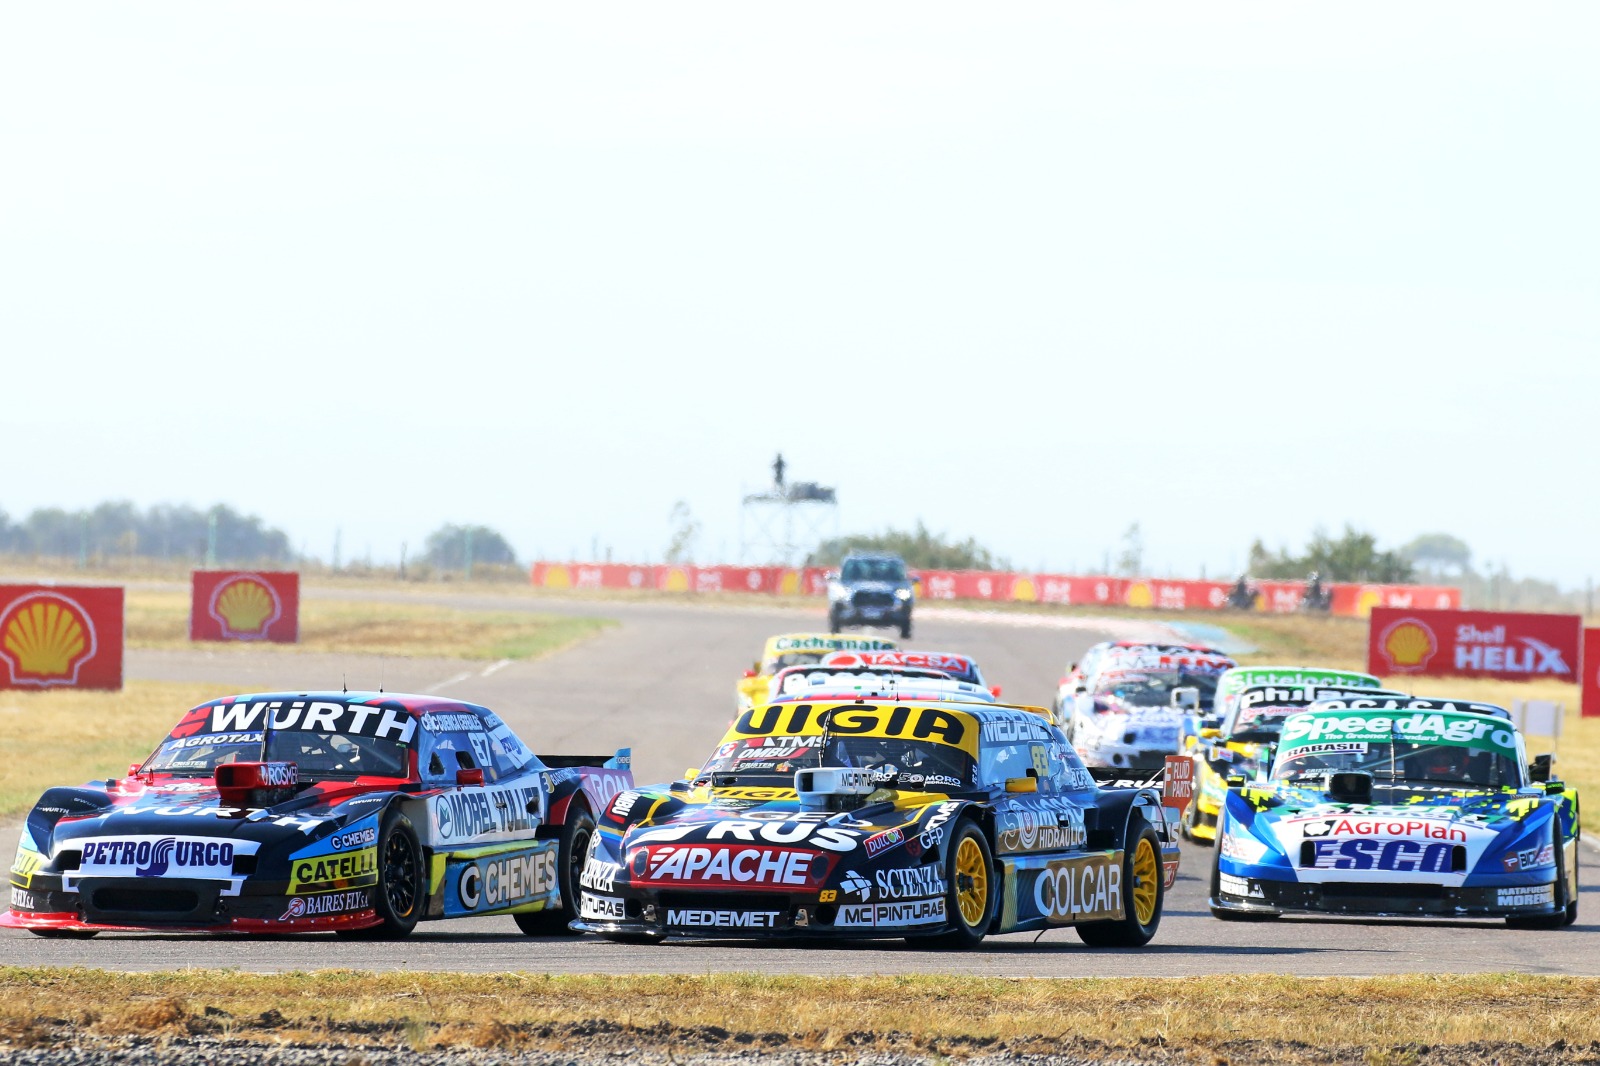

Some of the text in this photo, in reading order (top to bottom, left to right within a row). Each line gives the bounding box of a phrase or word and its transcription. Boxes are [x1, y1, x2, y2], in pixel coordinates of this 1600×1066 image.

[1457, 625, 1506, 643] Shell
[1455, 636, 1571, 674] HELIX
[211, 701, 417, 743] WÜRTH
[1282, 713, 1518, 749] SpeedAgro
[168, 734, 264, 750] AGROTAX
[738, 747, 796, 759] OMBU
[925, 774, 961, 785] MORO
[1173, 763, 1190, 779] FLUID
[1172, 781, 1191, 798] PARTS
[449, 792, 497, 837] MOREL
[342, 828, 375, 847] CHEMES
[706, 820, 862, 852] RUS
[1334, 819, 1467, 843] AgroPlan
[296, 853, 374, 883] CATELLI
[650, 847, 814, 884] APACHE
[485, 850, 557, 906] CHEMES
[875, 864, 945, 898] SCIENZA
[818, 890, 838, 902] 83
[1033, 863, 1122, 917] COLCAR
[306, 893, 344, 914] BAIRES
[345, 891, 362, 910] FLY
[845, 902, 944, 923] MC PINTURAS
[666, 909, 780, 927] MEDEMET
